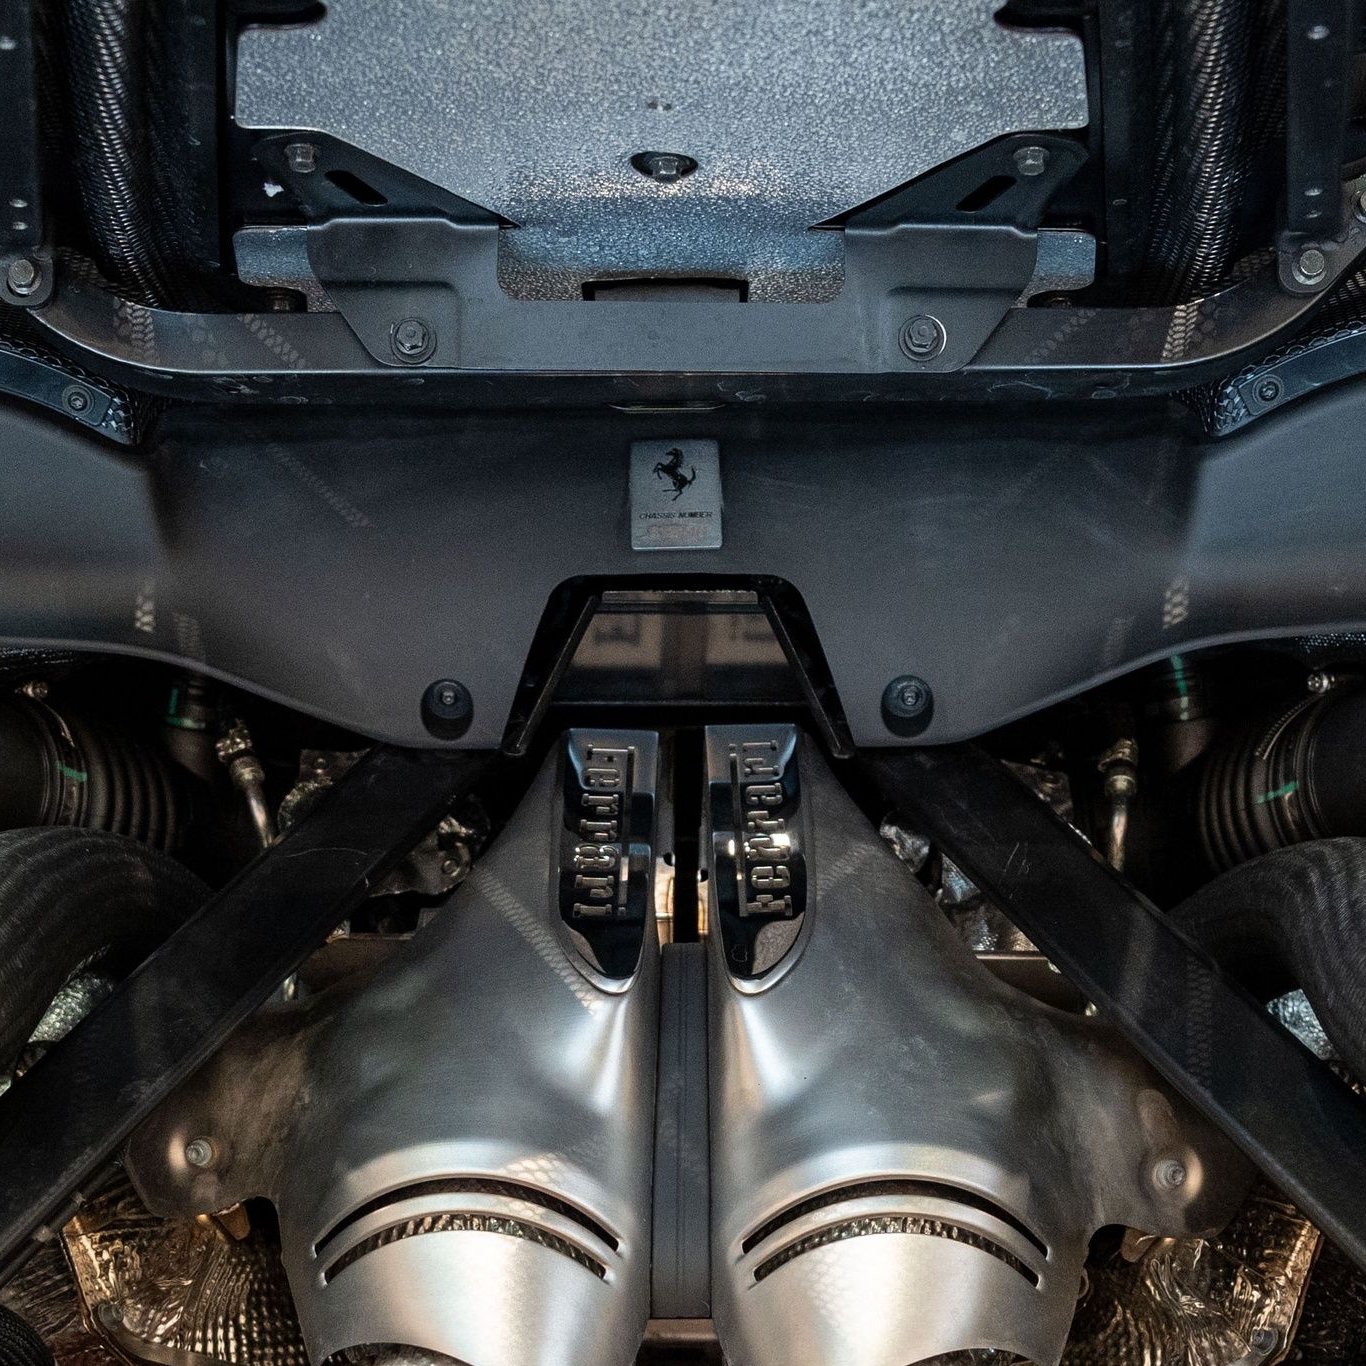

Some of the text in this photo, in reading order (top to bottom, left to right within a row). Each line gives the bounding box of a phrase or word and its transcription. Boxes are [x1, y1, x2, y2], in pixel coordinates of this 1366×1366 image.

[678, 511, 712, 519] NUMBER
[573, 743, 635, 918] Ferrari
[729, 740, 793, 918] Ferrari
